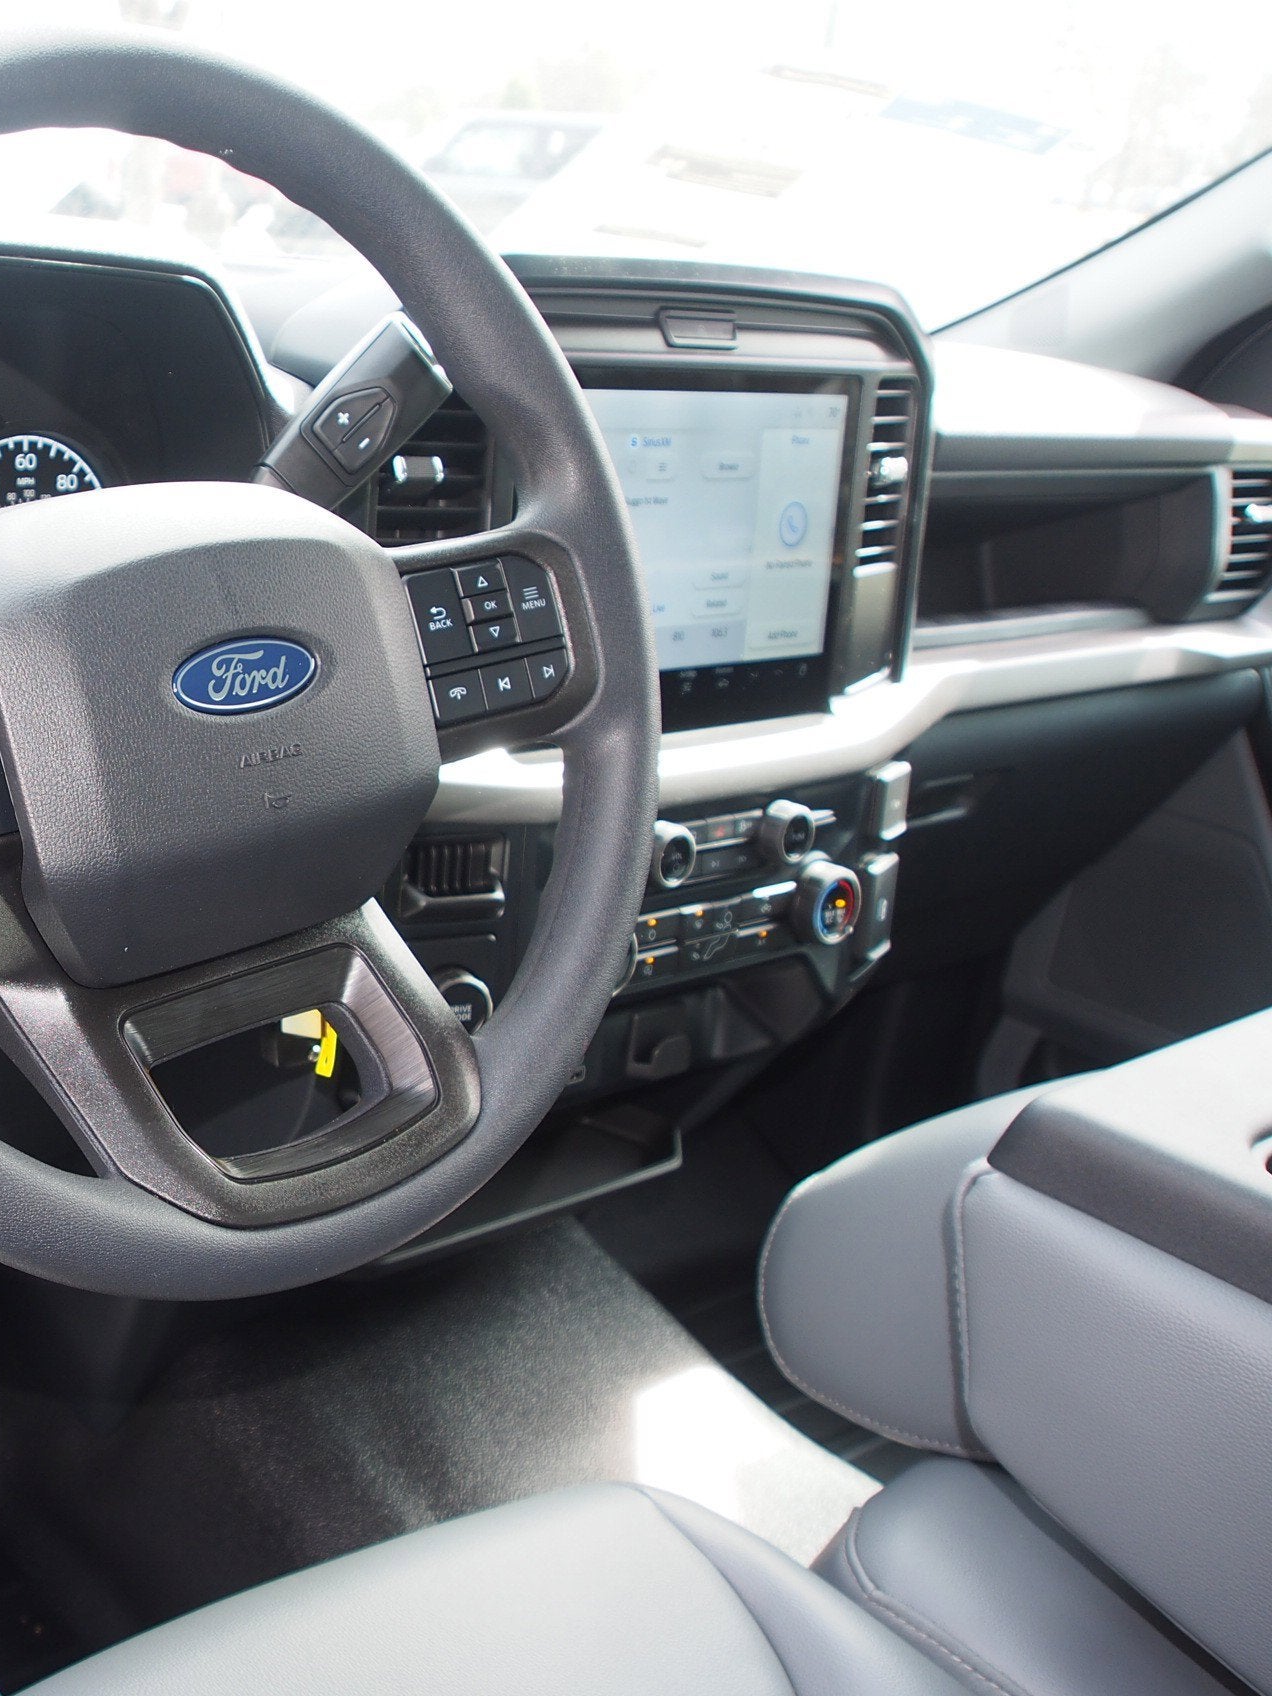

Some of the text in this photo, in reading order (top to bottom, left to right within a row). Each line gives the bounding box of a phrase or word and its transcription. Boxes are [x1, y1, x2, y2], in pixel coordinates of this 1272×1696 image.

[15, 453, 37, 471] 60
[16, 477, 35, 486] MPH
[56, 474, 78, 492] 80
[6, 492, 16, 501] 80
[23, 489, 35, 498] 100
[484, 600, 497, 610] OK
[522, 599, 546, 611] MENU
[428, 618, 453, 631] BACK
[207, 649, 290, 702] Ford
[239, 743, 303, 769] AIRBAG
[456, 1012, 472, 1021] ODE
